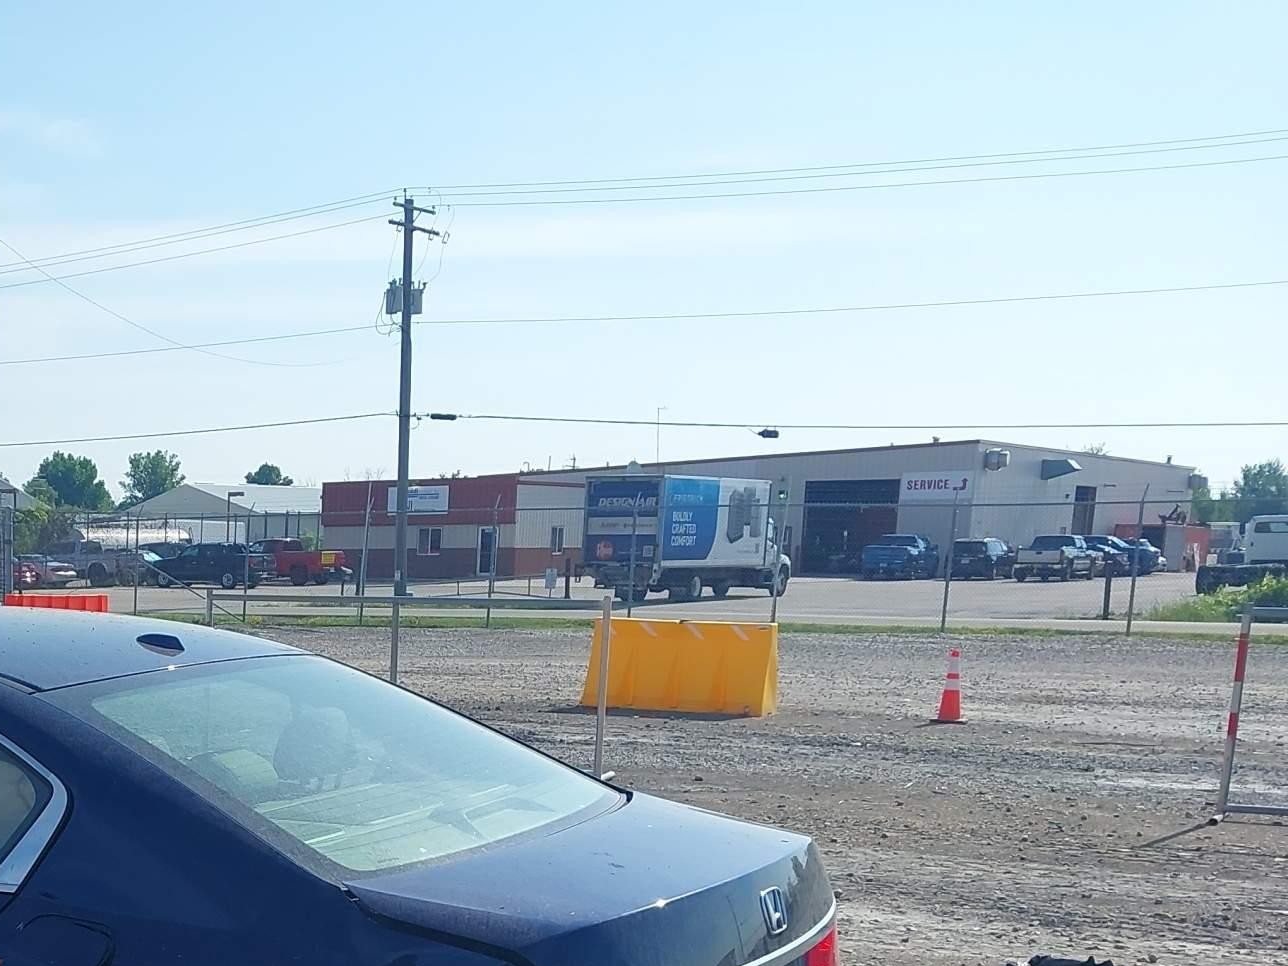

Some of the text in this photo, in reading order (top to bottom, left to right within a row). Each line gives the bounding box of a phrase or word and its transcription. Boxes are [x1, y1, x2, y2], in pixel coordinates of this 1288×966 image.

[906, 480, 950, 491] SERVICE
[672, 511, 694, 522] BOLDLY
[671, 523, 697, 534] CRAFTED
[670, 535, 697, 546] COMFORT
